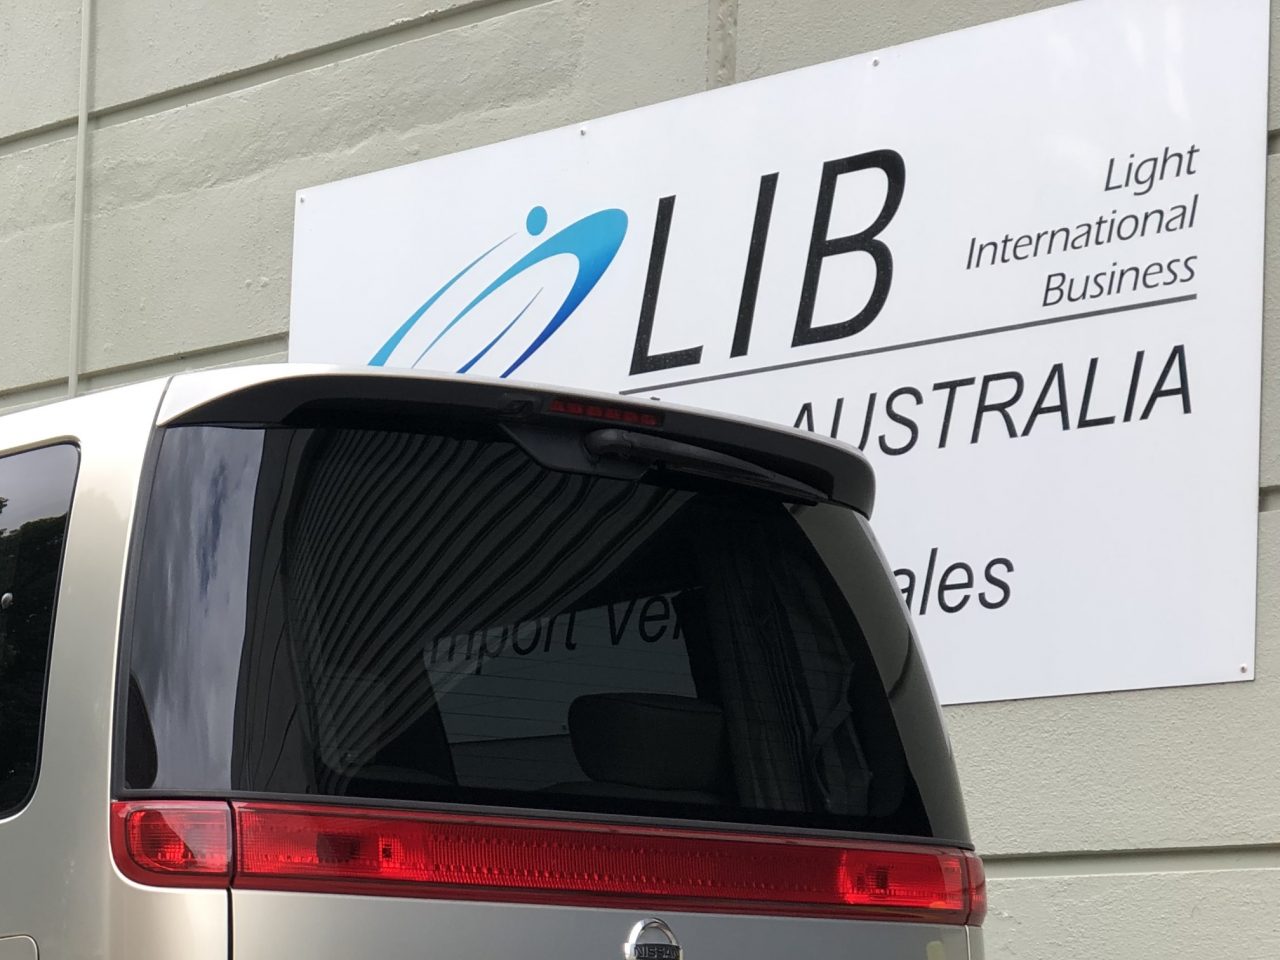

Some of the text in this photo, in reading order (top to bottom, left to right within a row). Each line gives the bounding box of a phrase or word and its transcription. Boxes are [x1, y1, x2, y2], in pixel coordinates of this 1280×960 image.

[1104, 144, 1200, 196] Light
[966, 194, 1199, 270] International
[629, 149, 906, 376] LIB
[1042, 255, 1198, 307] Business
[634, 944, 680, 960] NISSAN
